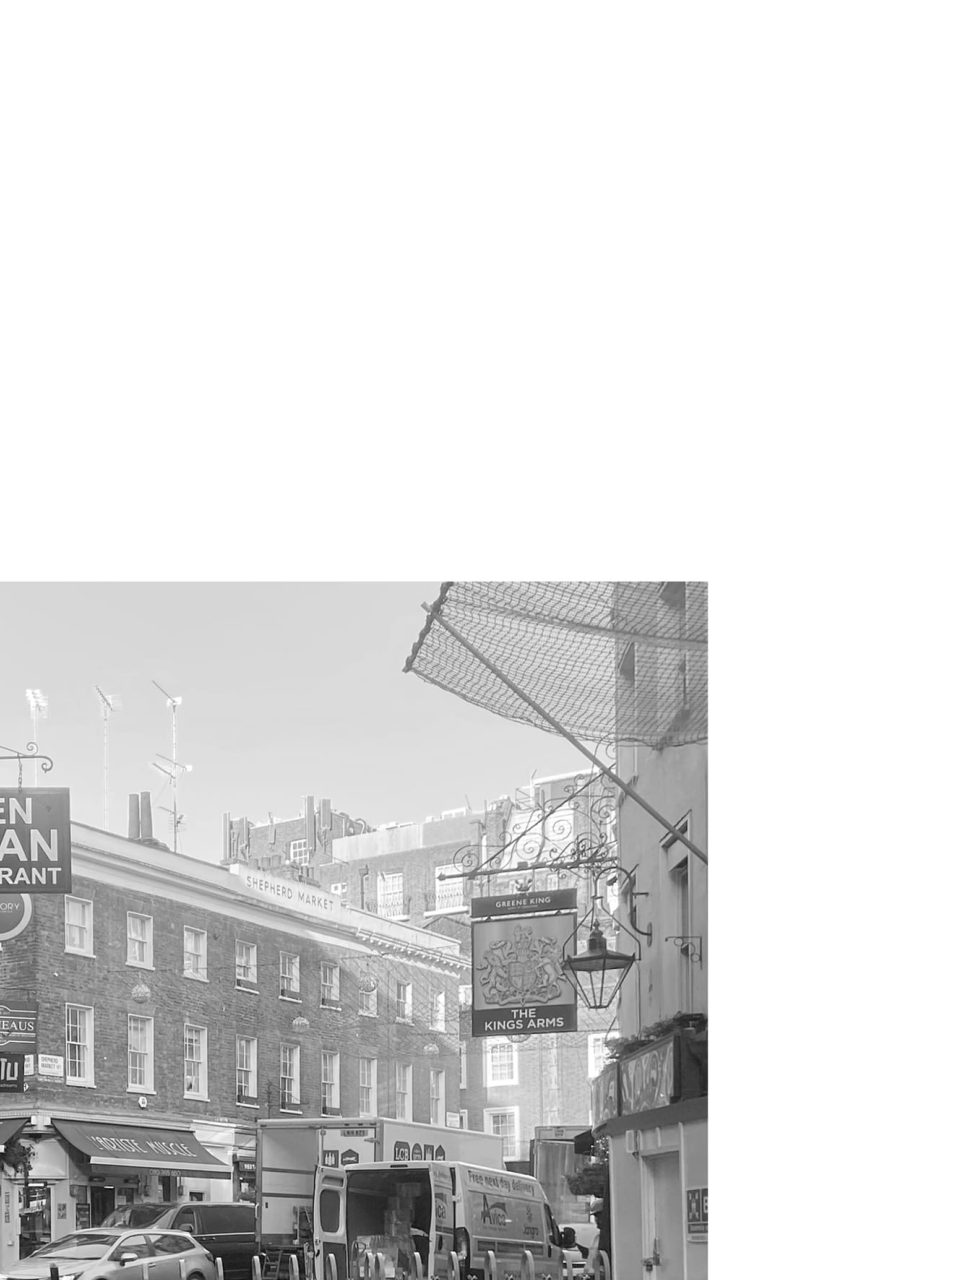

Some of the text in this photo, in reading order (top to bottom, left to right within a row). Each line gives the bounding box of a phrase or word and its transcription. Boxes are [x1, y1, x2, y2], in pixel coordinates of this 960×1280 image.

[246, 876, 334, 911] SHEPHERD MARKET
[495, 898, 527, 908] GREENE
[529, 896, 551, 905] KING
[511, 1008, 537, 1019] THE
[484, 1017, 565, 1032] KINGS ARMS
[468, 1169, 484, 1186] Free
[484, 1174, 500, 1189] next
